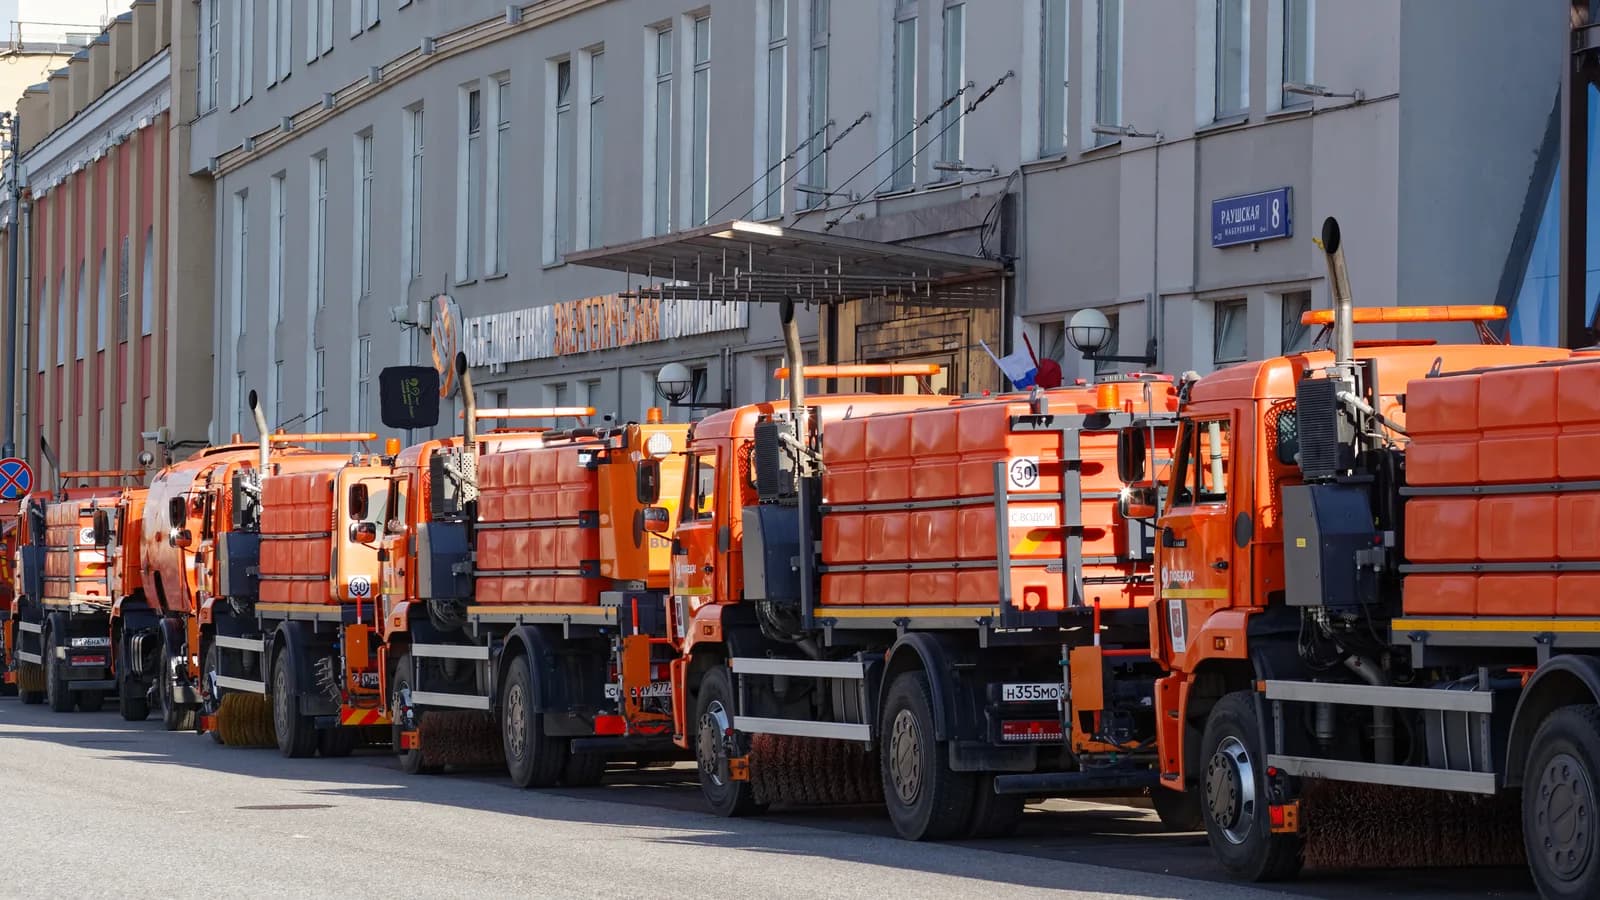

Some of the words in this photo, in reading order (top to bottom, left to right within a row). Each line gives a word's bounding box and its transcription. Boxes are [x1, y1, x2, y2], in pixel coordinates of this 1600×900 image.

[1221, 204, 1260, 225] РАУШСКАЯ
[1271, 198, 1280, 229] 8
[1016, 466, 1032, 481] 30
[354, 582, 366, 592] 30
[1006, 685, 1058, 700] Н355МО
